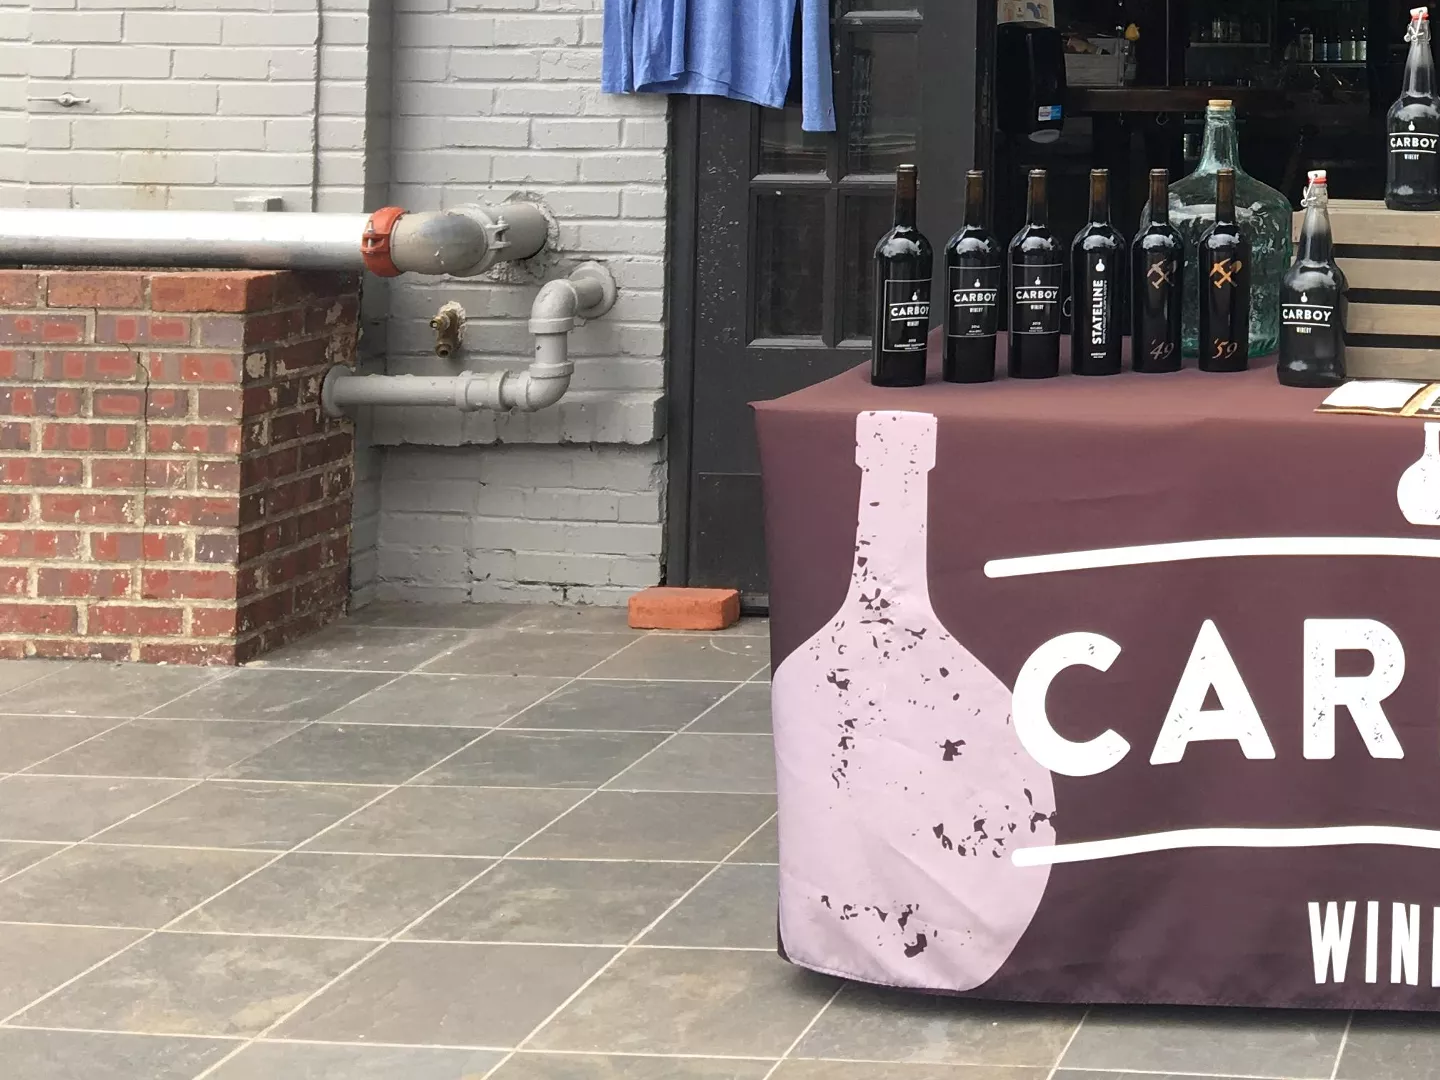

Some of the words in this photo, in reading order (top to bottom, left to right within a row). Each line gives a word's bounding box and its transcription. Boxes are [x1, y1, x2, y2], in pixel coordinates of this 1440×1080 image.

[1390, 137, 1437, 148] CARBOY
[954, 293, 997, 303] CARBOY
[1016, 290, 1058, 300] CARBOY
[891, 306, 929, 317] CARBOY
[1092, 280, 1103, 345] STATELINE
[1282, 309, 1331, 321] CARBOY
[1150, 339, 1174, 359] '49
[1212, 338, 1238, 359] '59
